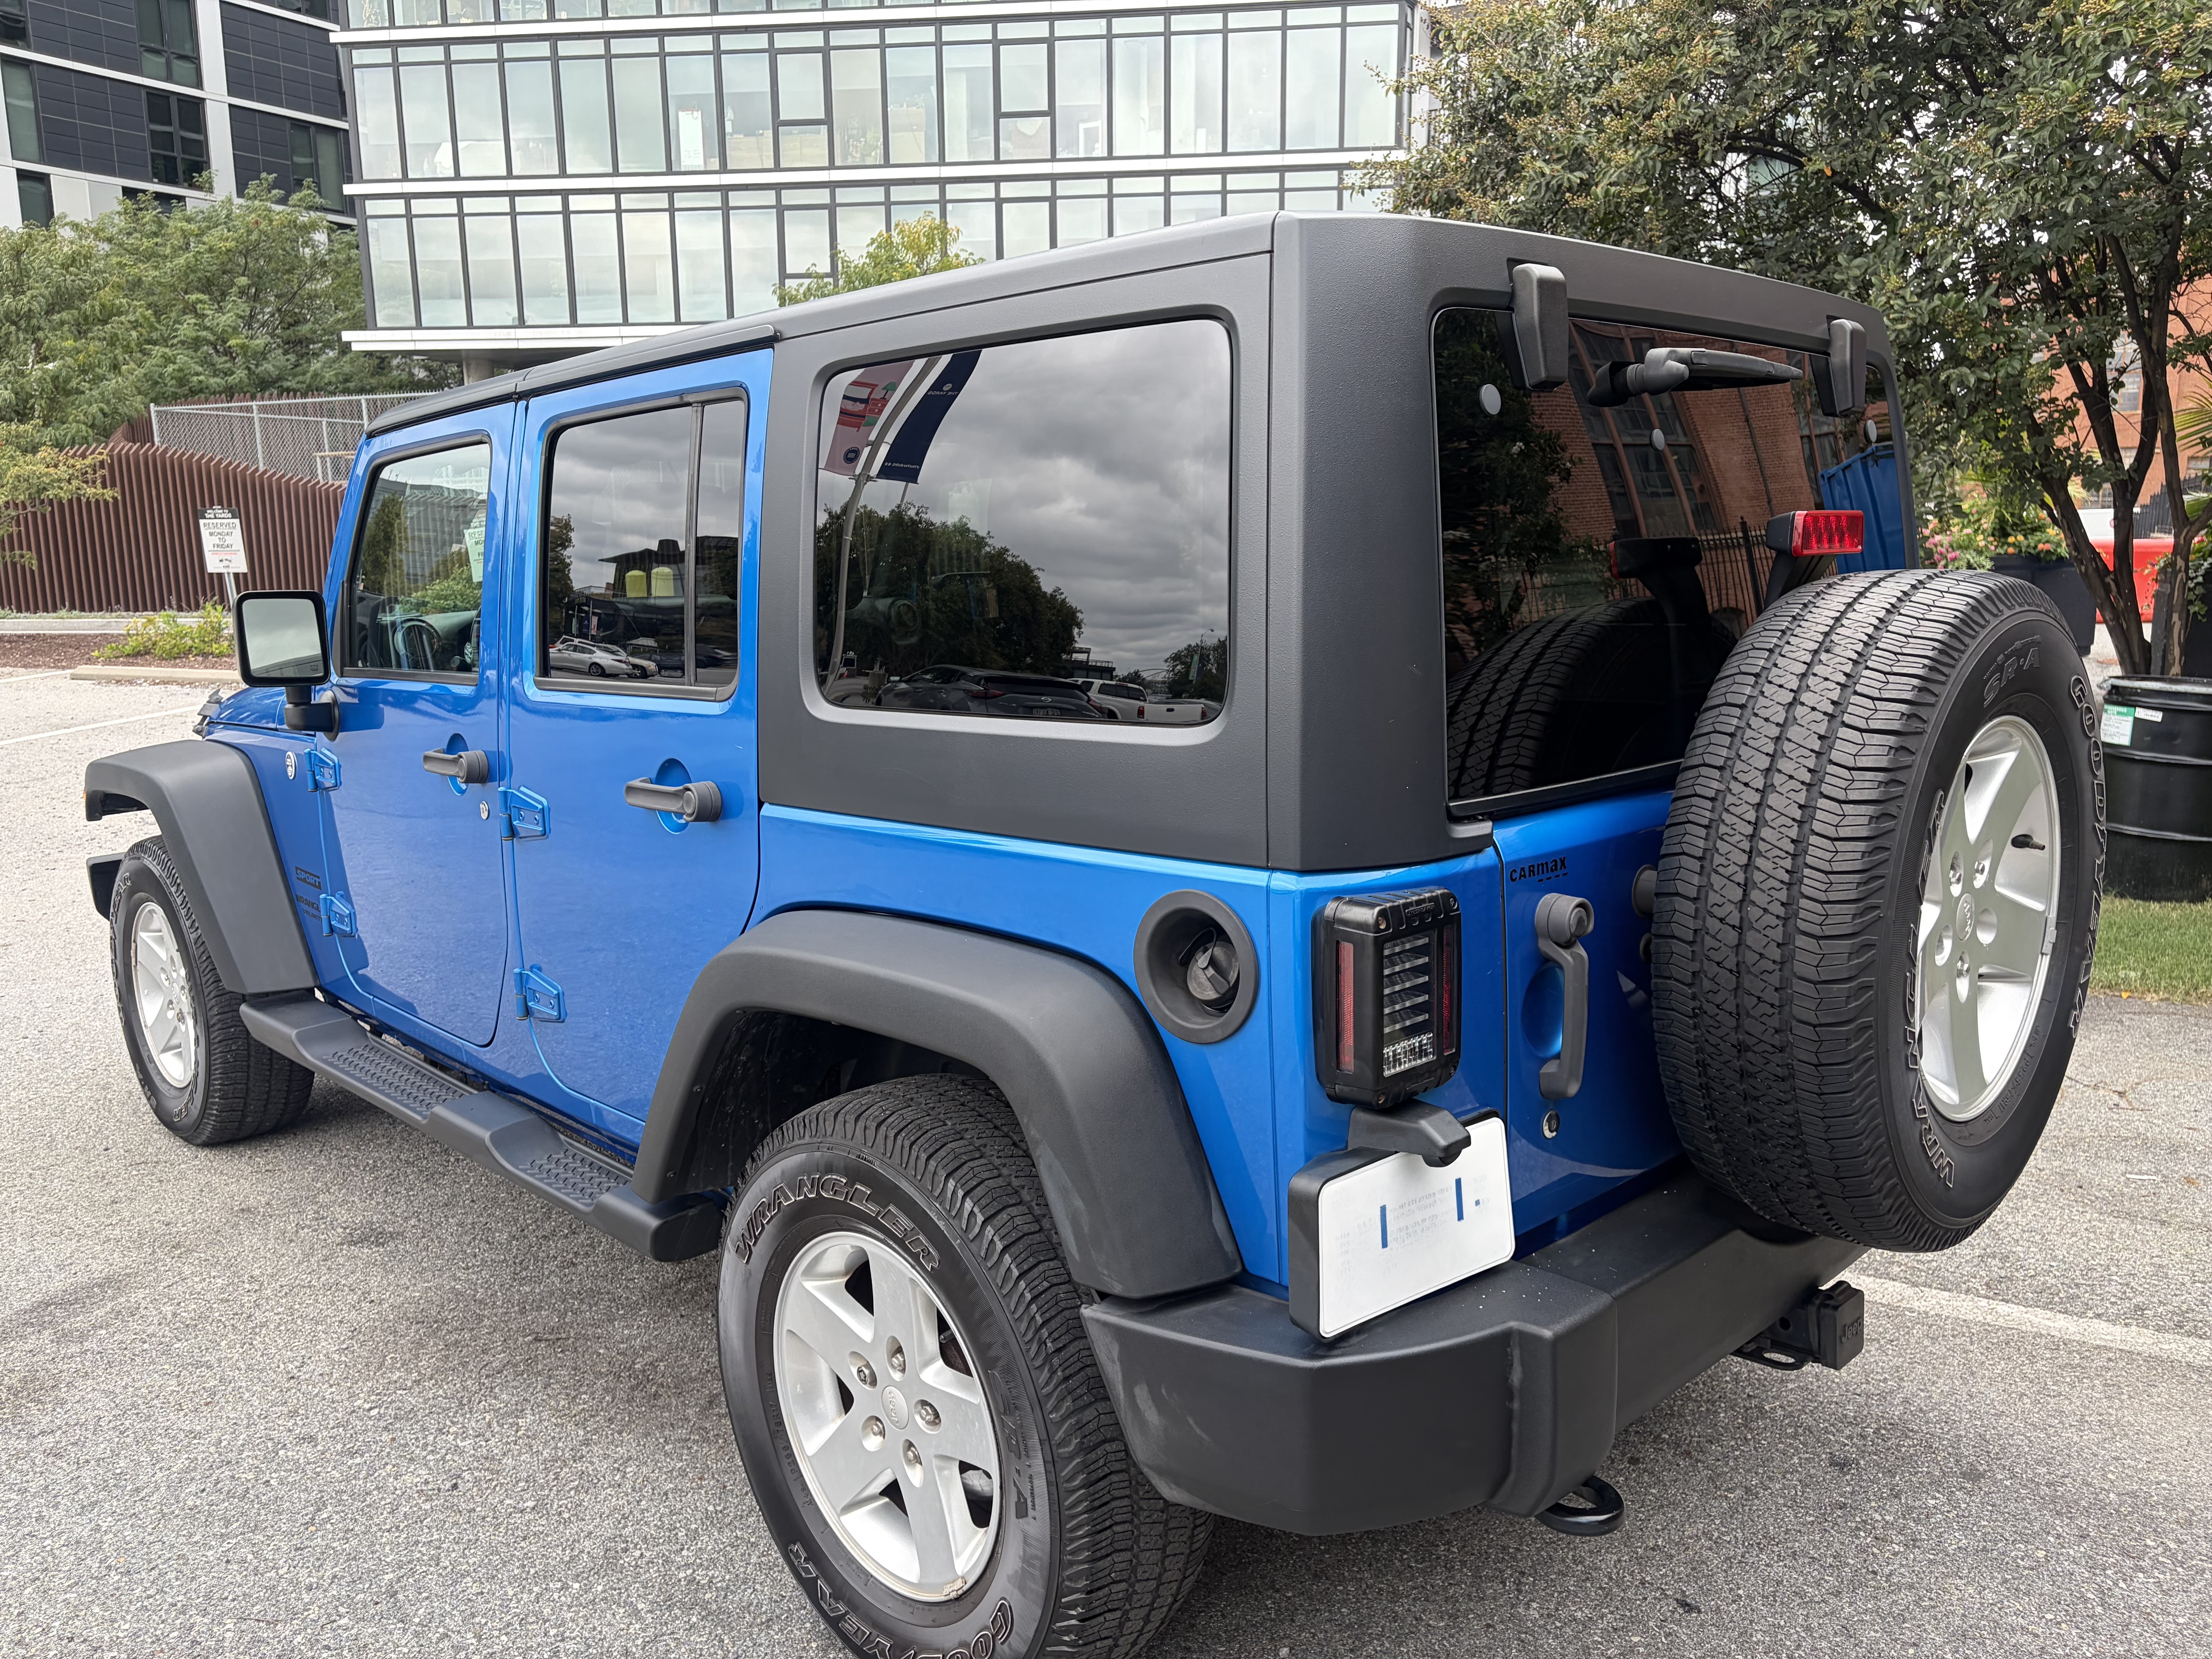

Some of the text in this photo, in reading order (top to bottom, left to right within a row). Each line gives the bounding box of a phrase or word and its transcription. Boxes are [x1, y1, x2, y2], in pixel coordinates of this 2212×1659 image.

[2068, 674, 2107, 1039] GOODYEAR
[296, 869, 319, 886] SPORT
[295, 894, 321, 913] WRANGL
[302, 908, 323, 922] UNLIMIT
[735, 1172, 940, 1272] WRANGLER
[1841, 1317, 1862, 1343] Jeep
